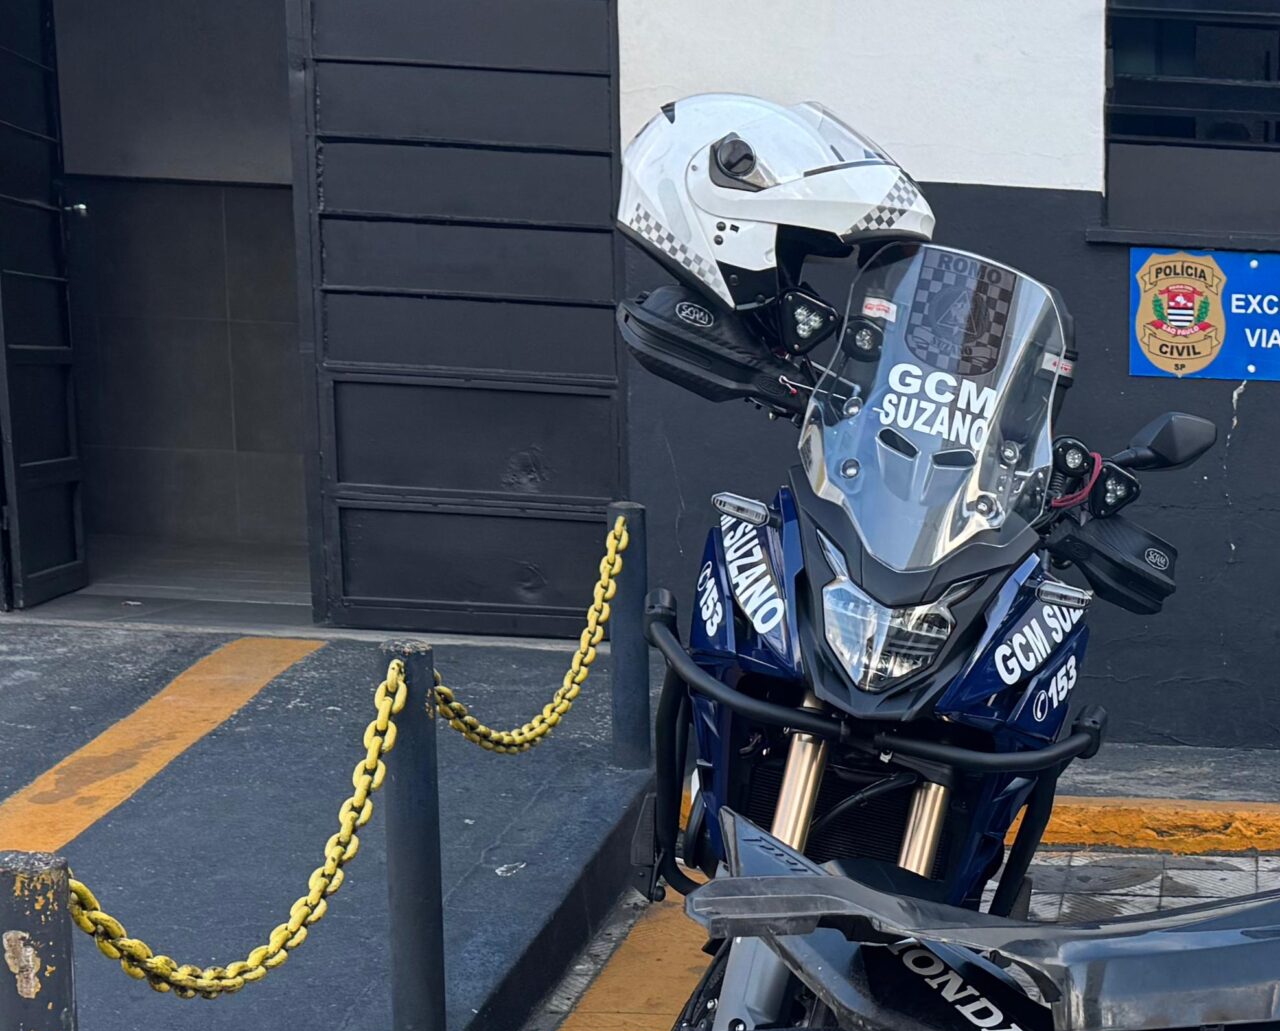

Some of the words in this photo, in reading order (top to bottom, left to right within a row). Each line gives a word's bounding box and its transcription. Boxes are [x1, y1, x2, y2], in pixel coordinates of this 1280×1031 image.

[938, 254, 1003, 284] ROMO
[1155, 262, 1207, 280] POLÍCIA
[1159, 343, 1201, 357] CIVIL
[1174, 363, 1186, 371] SP
[888, 363, 997, 418] GCM
[879, 393, 990, 450] SUZANO
[722, 521, 785, 634] SUZANO
[699, 577, 723, 637] 153
[994, 618, 1051, 685] GCM
[1048, 655, 1078, 709] 153
